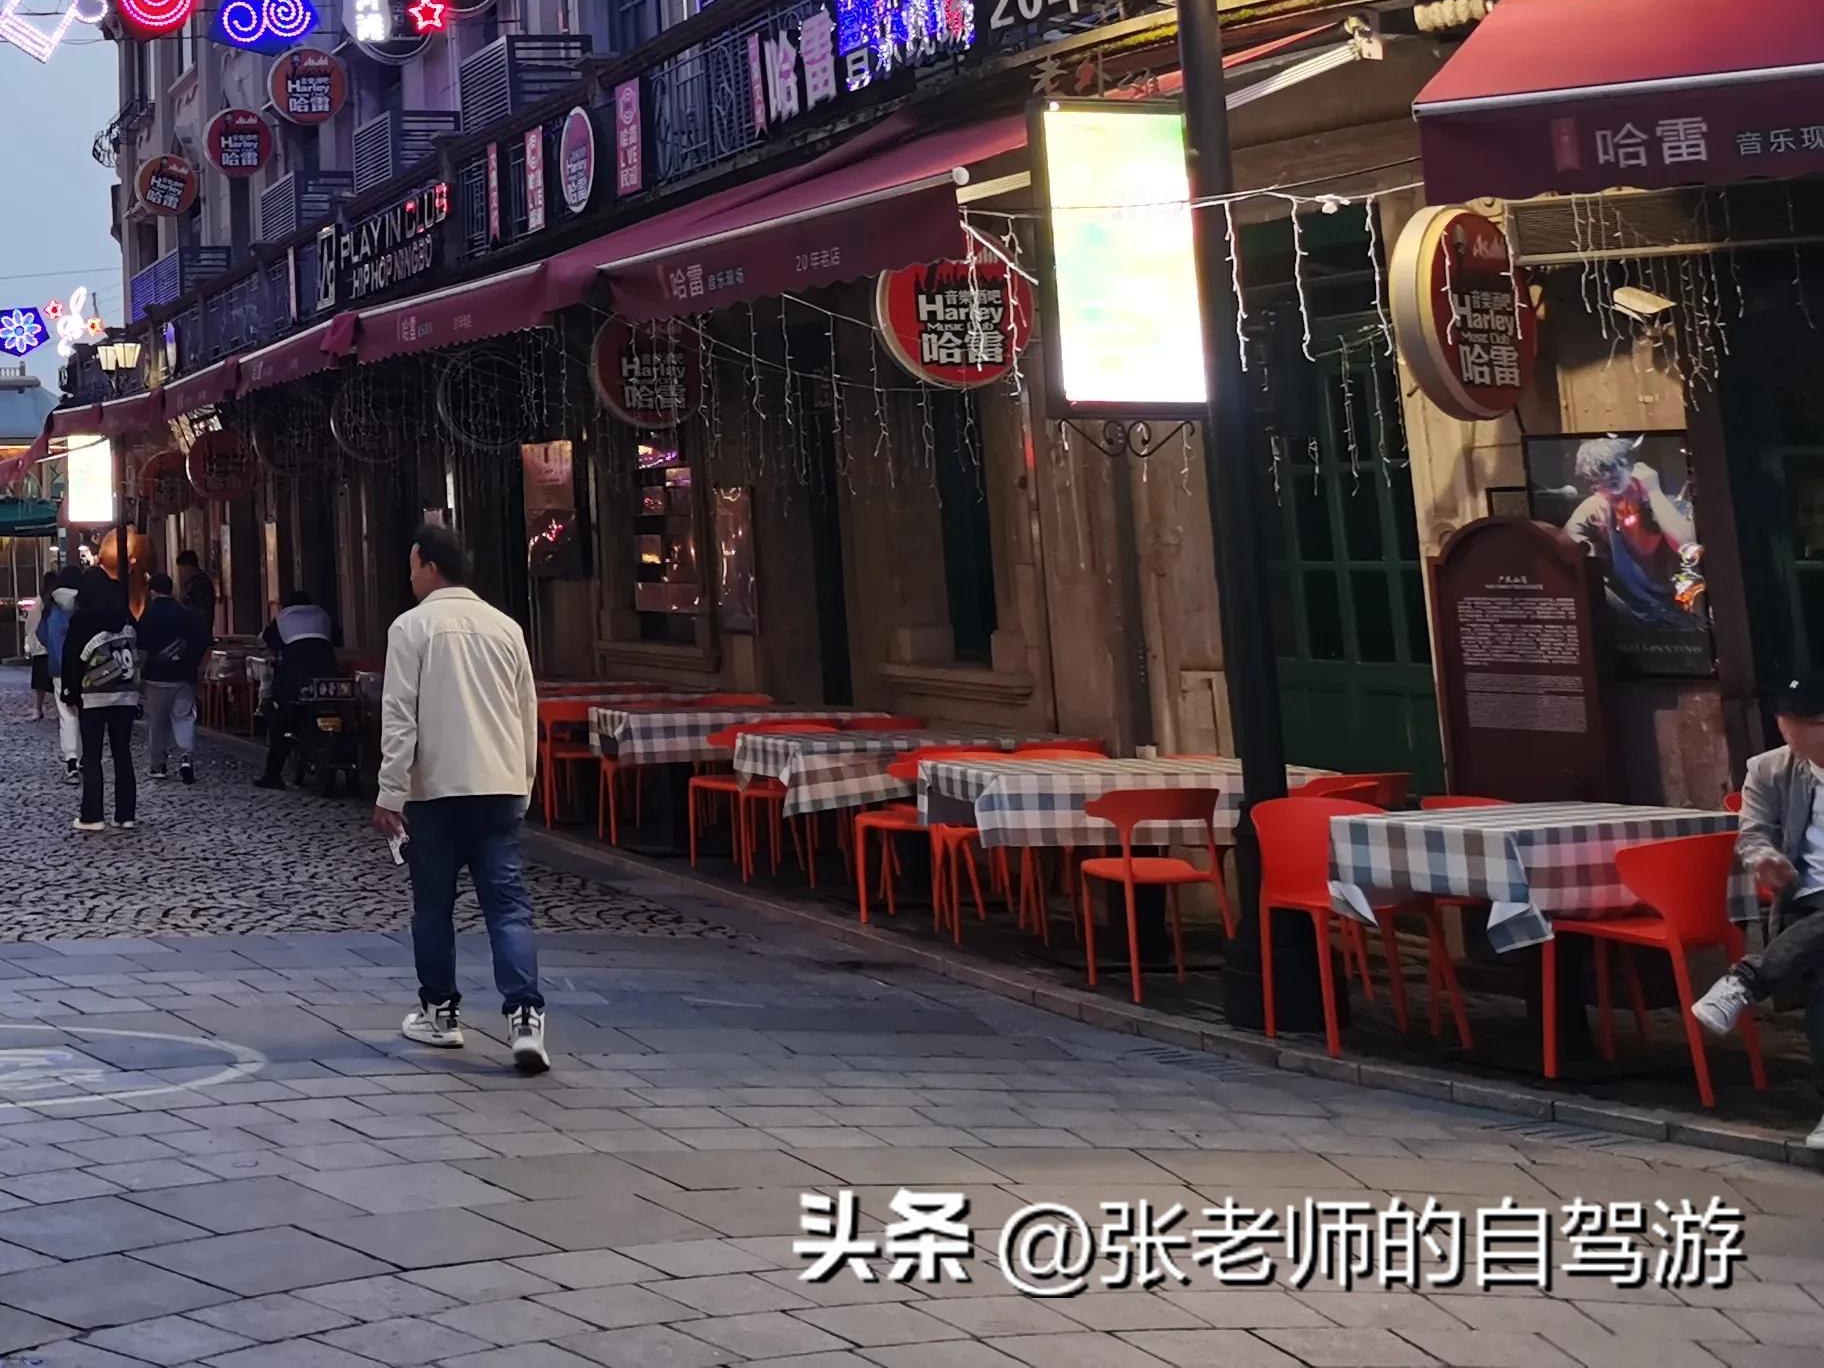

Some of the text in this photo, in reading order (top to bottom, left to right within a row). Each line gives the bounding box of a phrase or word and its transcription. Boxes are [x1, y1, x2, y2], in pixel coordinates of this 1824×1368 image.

[762, 5, 837, 124] 哈雷
[288, 96, 330, 113] 哈雷
[1594, 115, 1709, 169] 哈雷
[669, 263, 705, 301] 哈雷
[927, 322, 965, 332] Music
[1453, 292, 1516, 336] Harley
[921, 331, 1005, 364] 哈雷
[1458, 343, 1521, 387] 哈雷
